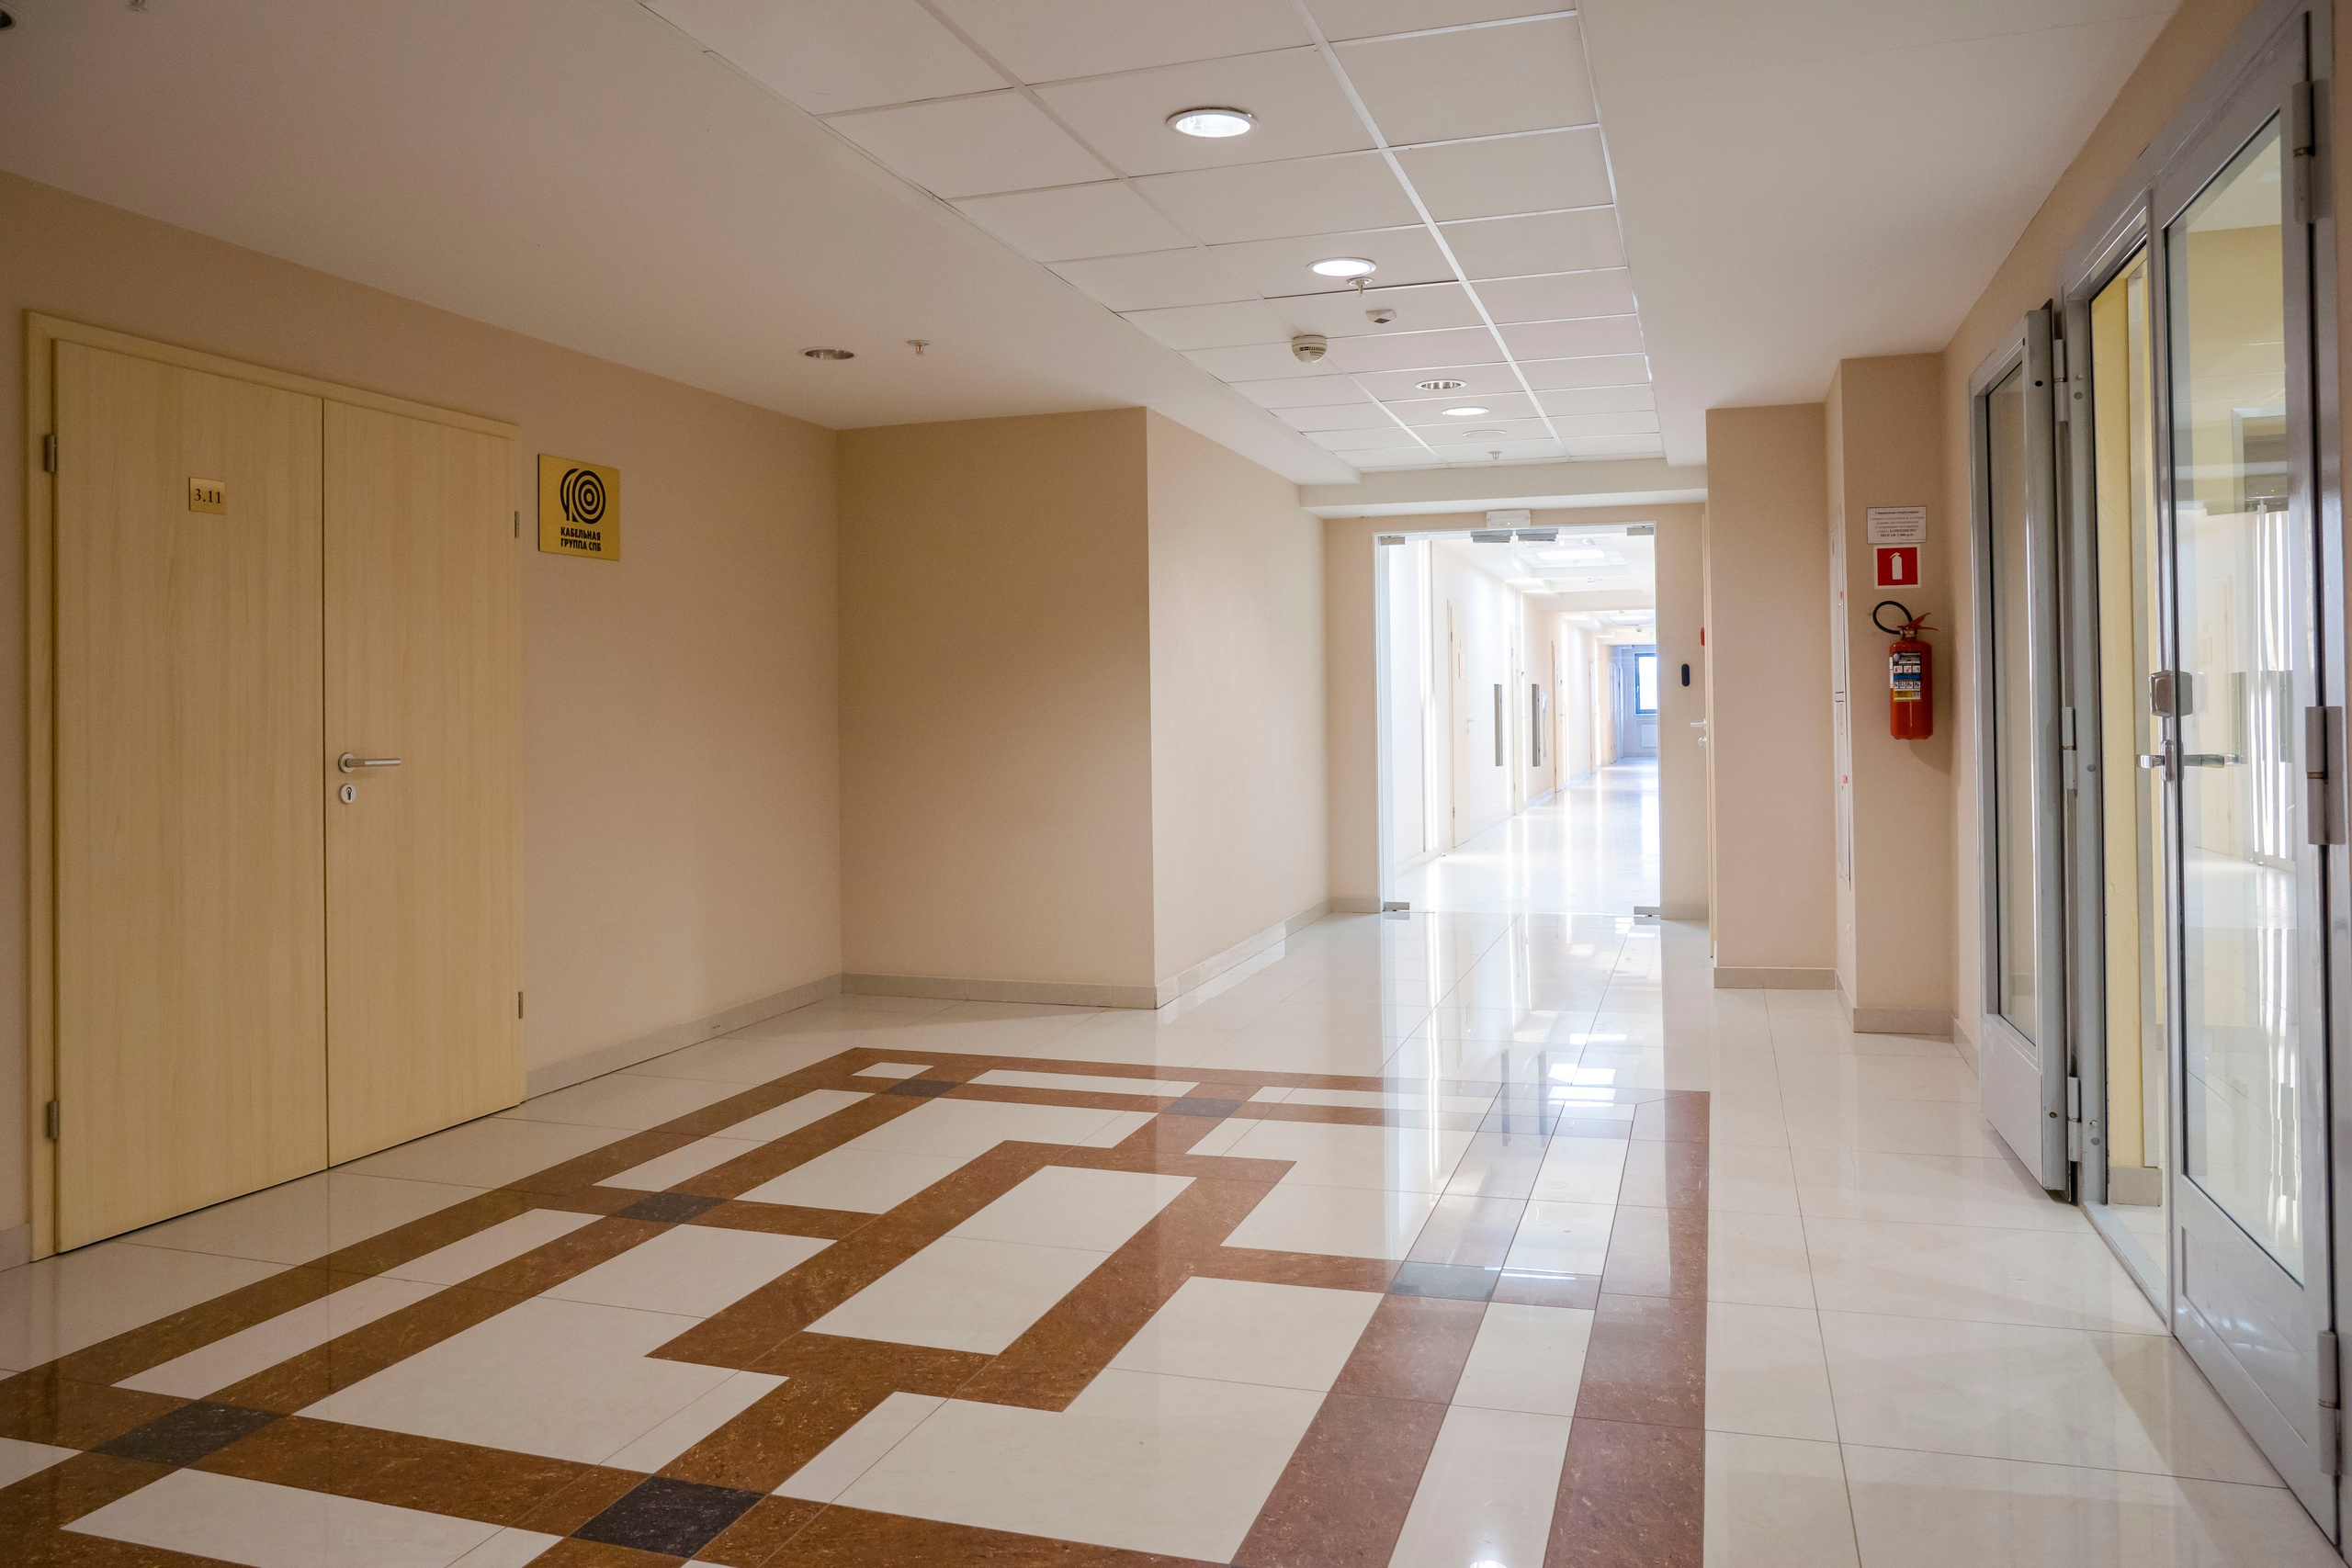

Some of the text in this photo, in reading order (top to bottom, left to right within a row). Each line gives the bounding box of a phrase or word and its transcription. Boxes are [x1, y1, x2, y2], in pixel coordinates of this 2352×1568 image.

[194, 488, 222, 504] 3.11
[560, 526, 601, 541] КАБЕЛЬНАЯ
[560, 537, 601, 552] ГРУППА СПБ
